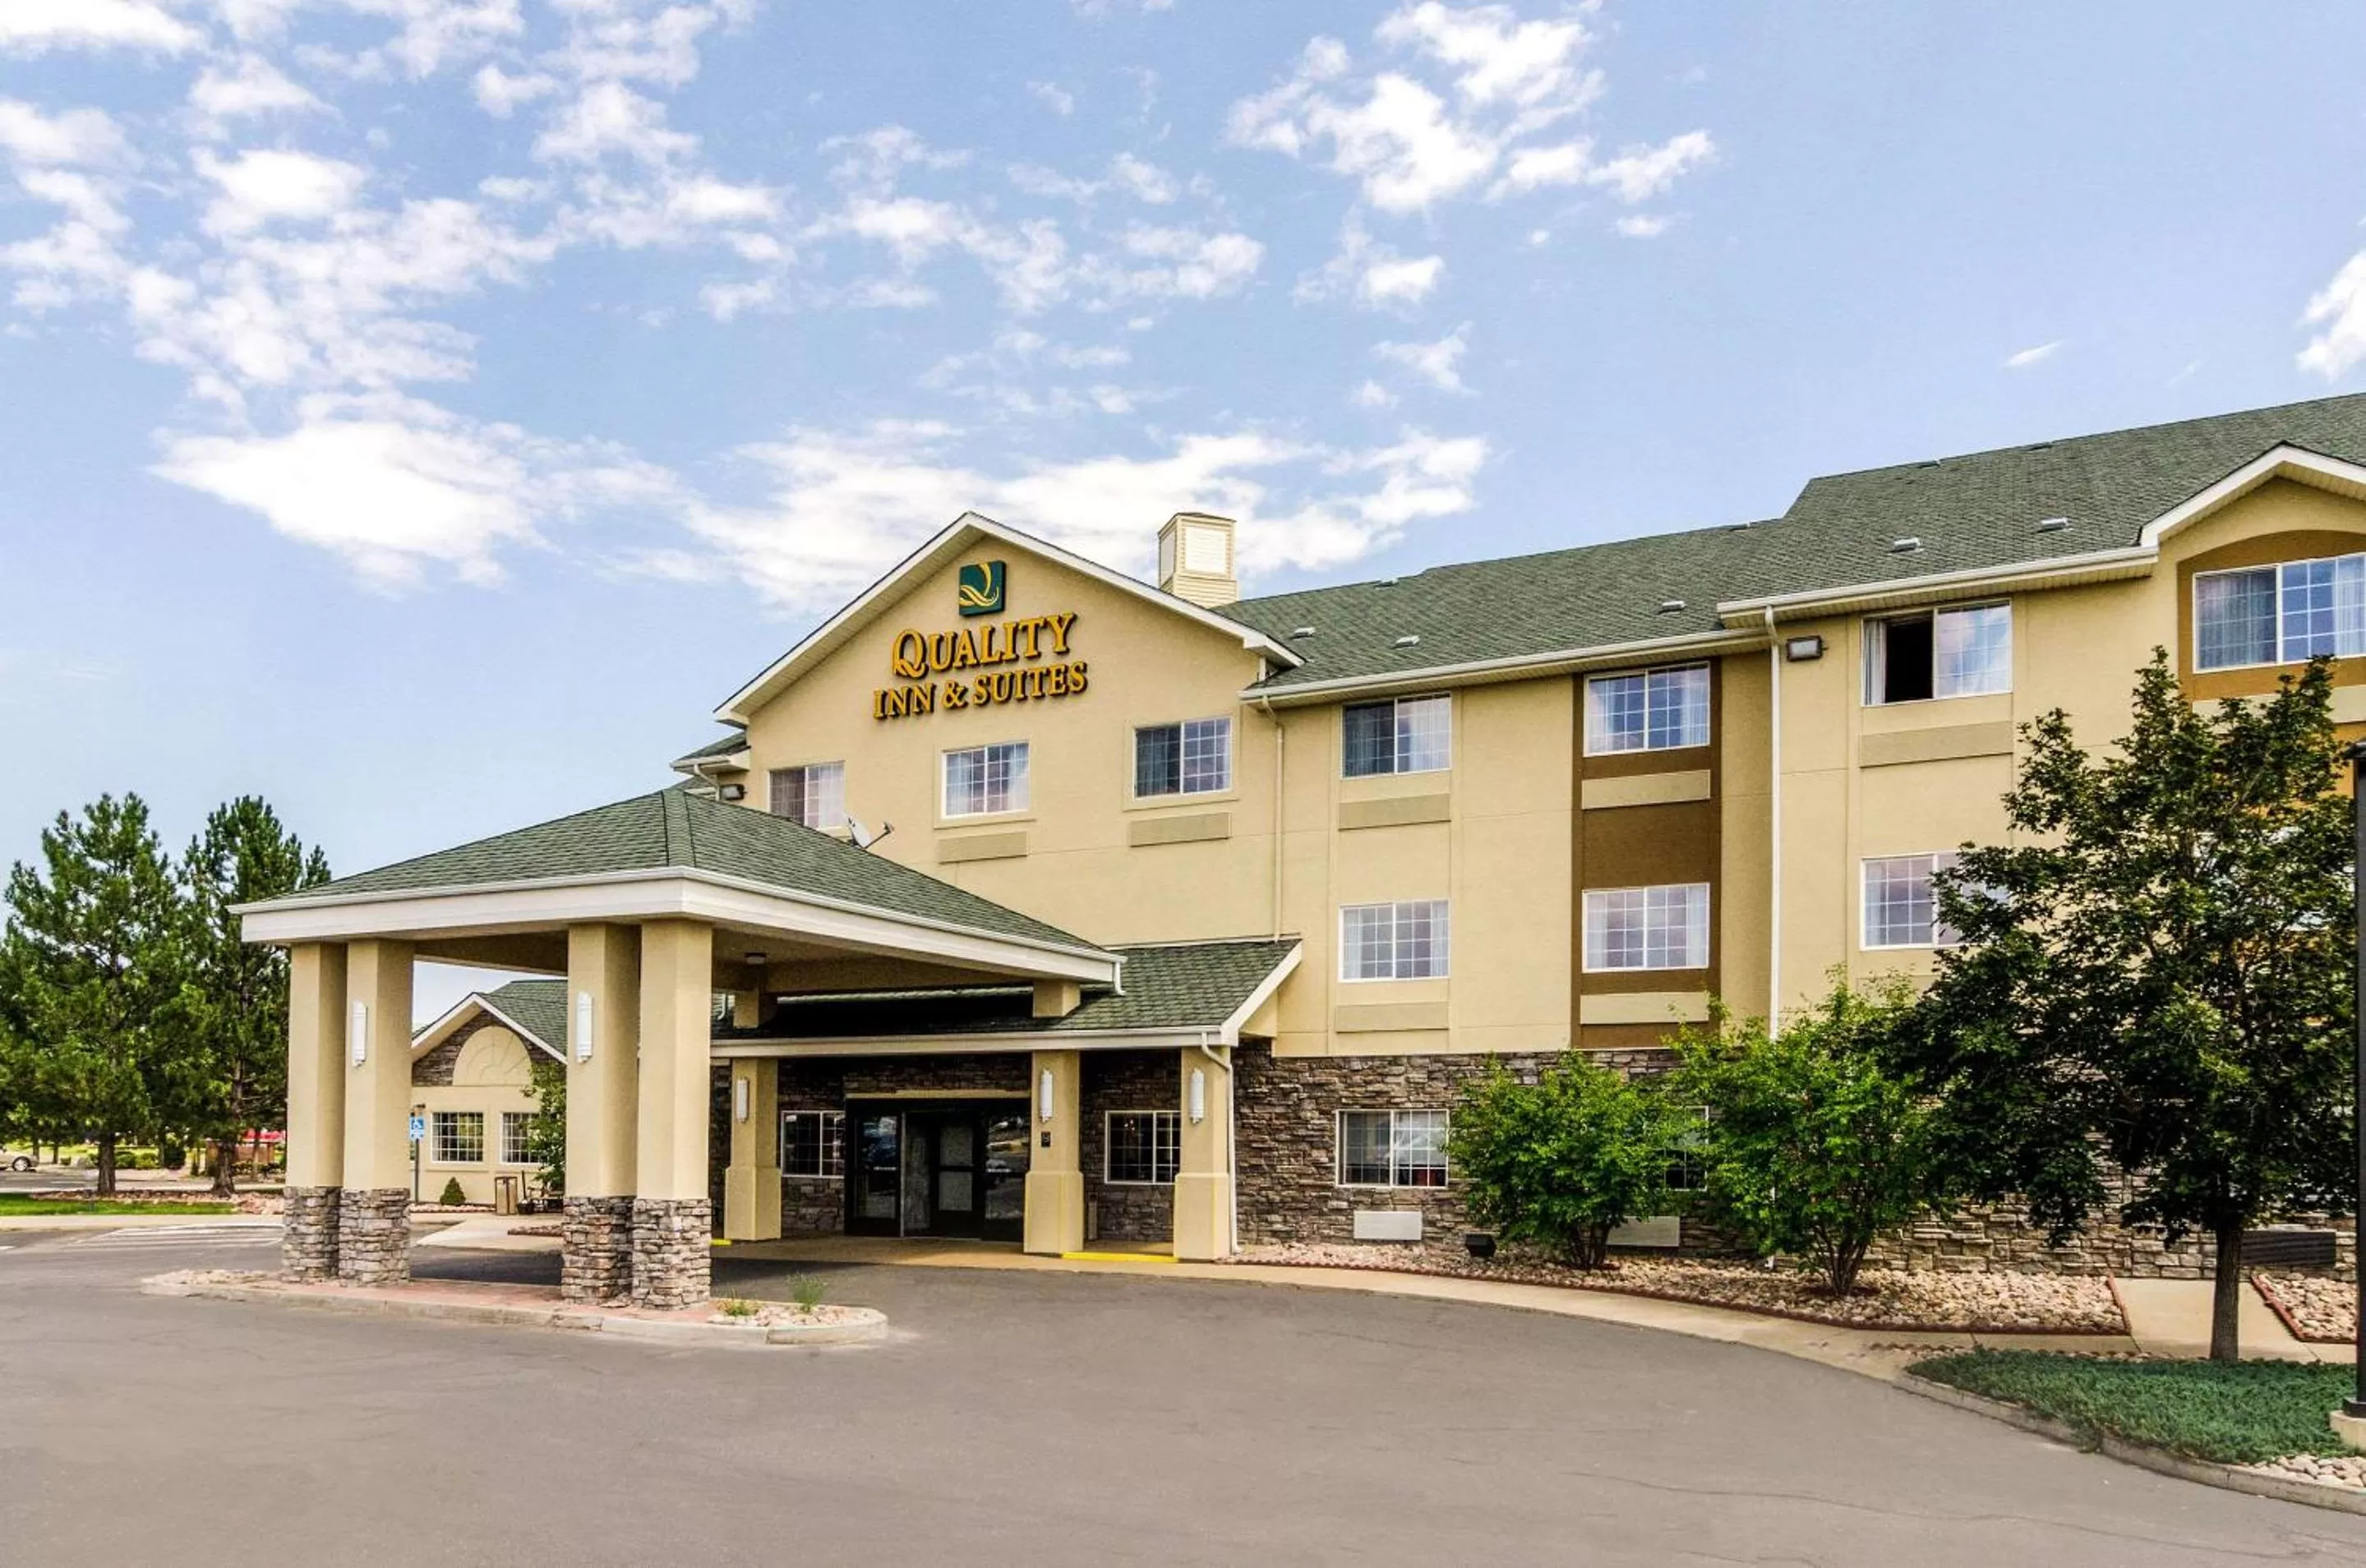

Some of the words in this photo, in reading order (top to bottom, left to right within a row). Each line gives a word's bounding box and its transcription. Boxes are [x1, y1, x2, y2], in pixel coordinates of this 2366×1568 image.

[892, 613, 1077, 679] QUALITY
[873, 683, 935, 719] INN
[942, 680, 968, 708] &
[972, 661, 1087, 706] SUITES
